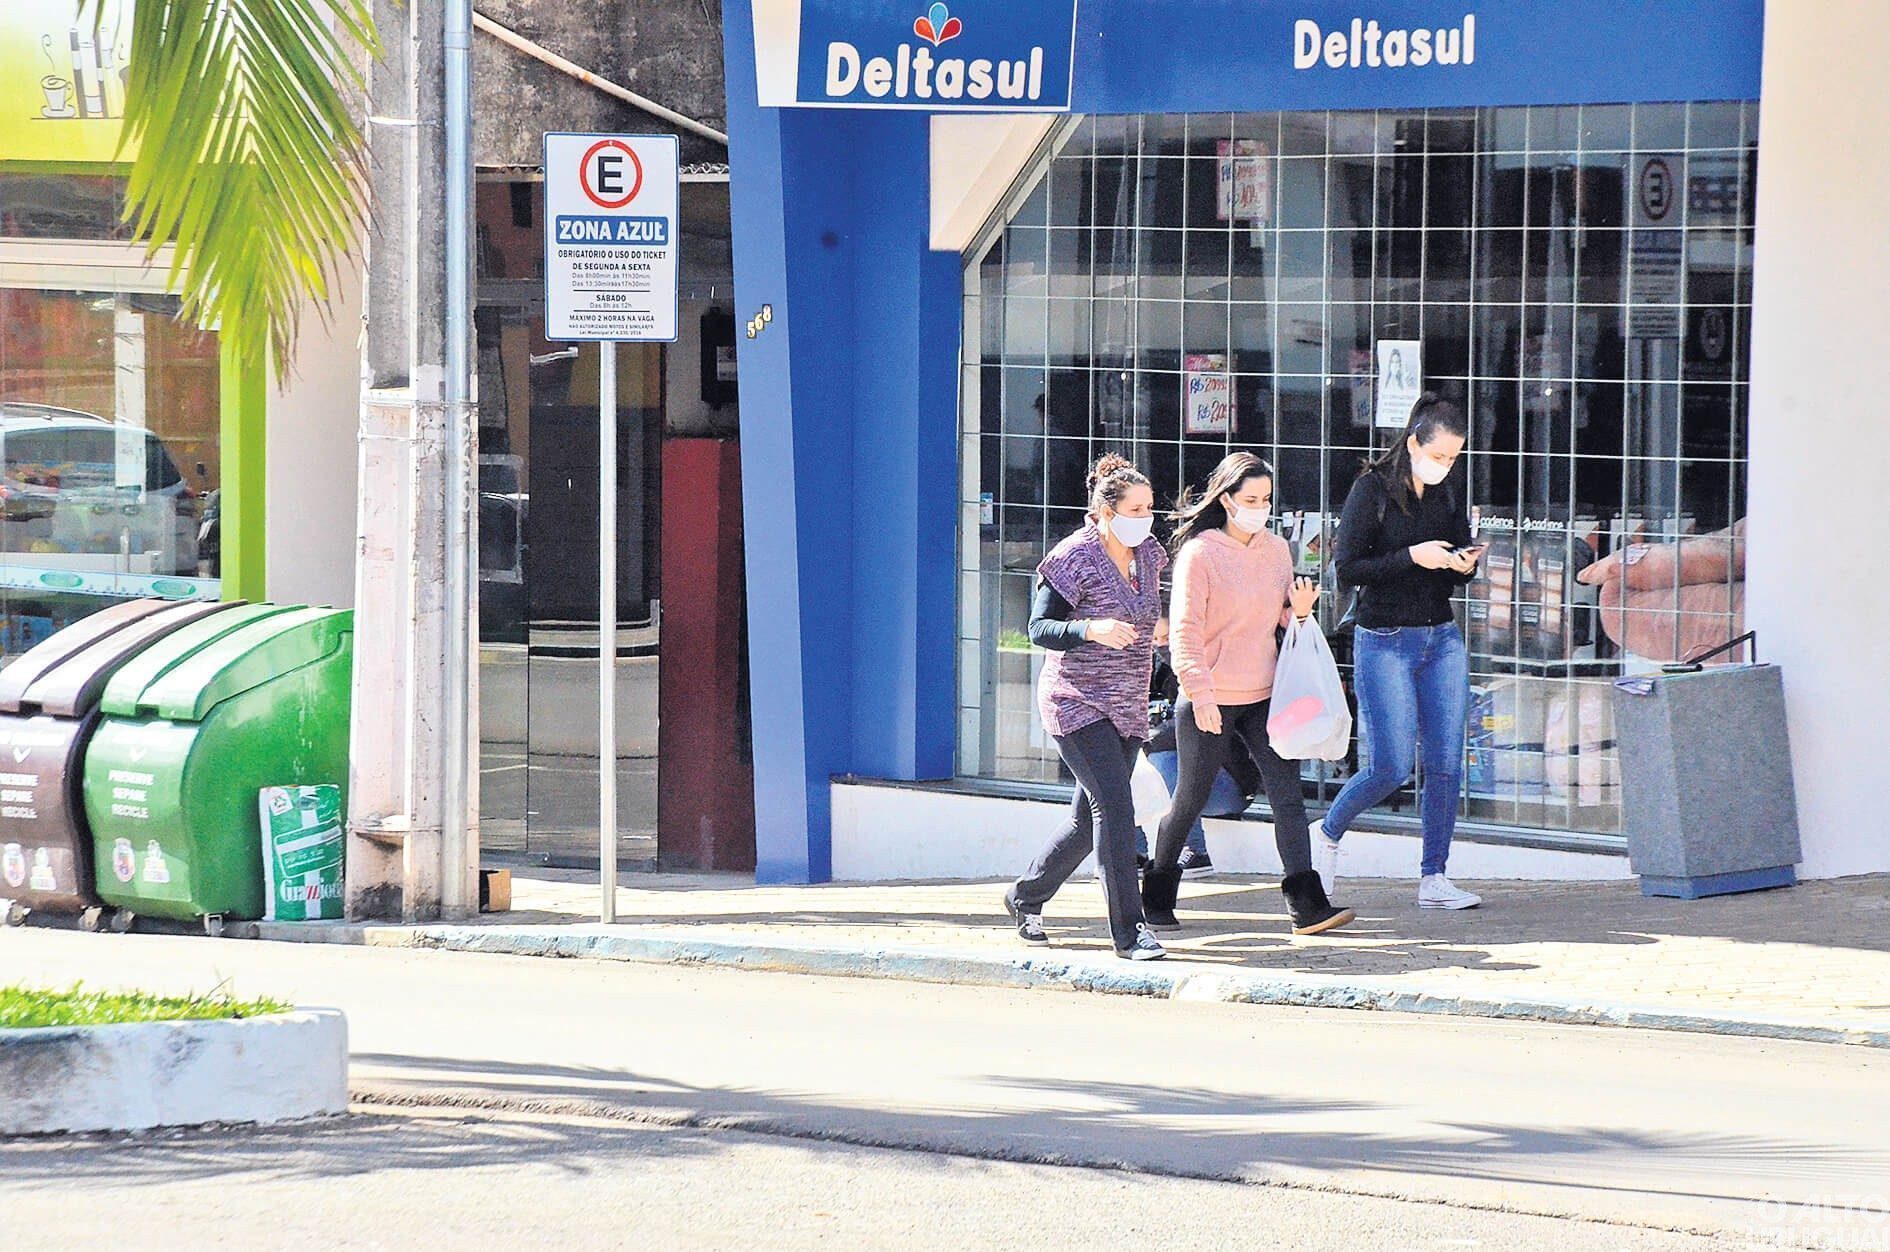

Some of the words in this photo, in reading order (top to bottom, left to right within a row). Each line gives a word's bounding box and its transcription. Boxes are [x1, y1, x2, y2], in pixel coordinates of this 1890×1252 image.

[1294, 14, 1476, 70] Deltasul
[826, 42, 1043, 100] Deltasul
[597, 156, 623, 194] E
[559, 220, 612, 240] ZONA
[616, 221, 666, 241] AZUL
[572, 262, 582, 270] DE
[584, 262, 619, 271] SEGUNDA
[621, 263, 627, 271] A
[628, 263, 651, 271] SEXTA
[607, 250, 613, 259] O
[614, 250, 629, 259] USO
[631, 251, 641, 259] DO
[643, 251, 666, 260] TICKET
[746, 304, 772, 338] 568
[1532, 518, 1564, 529] cadnce
